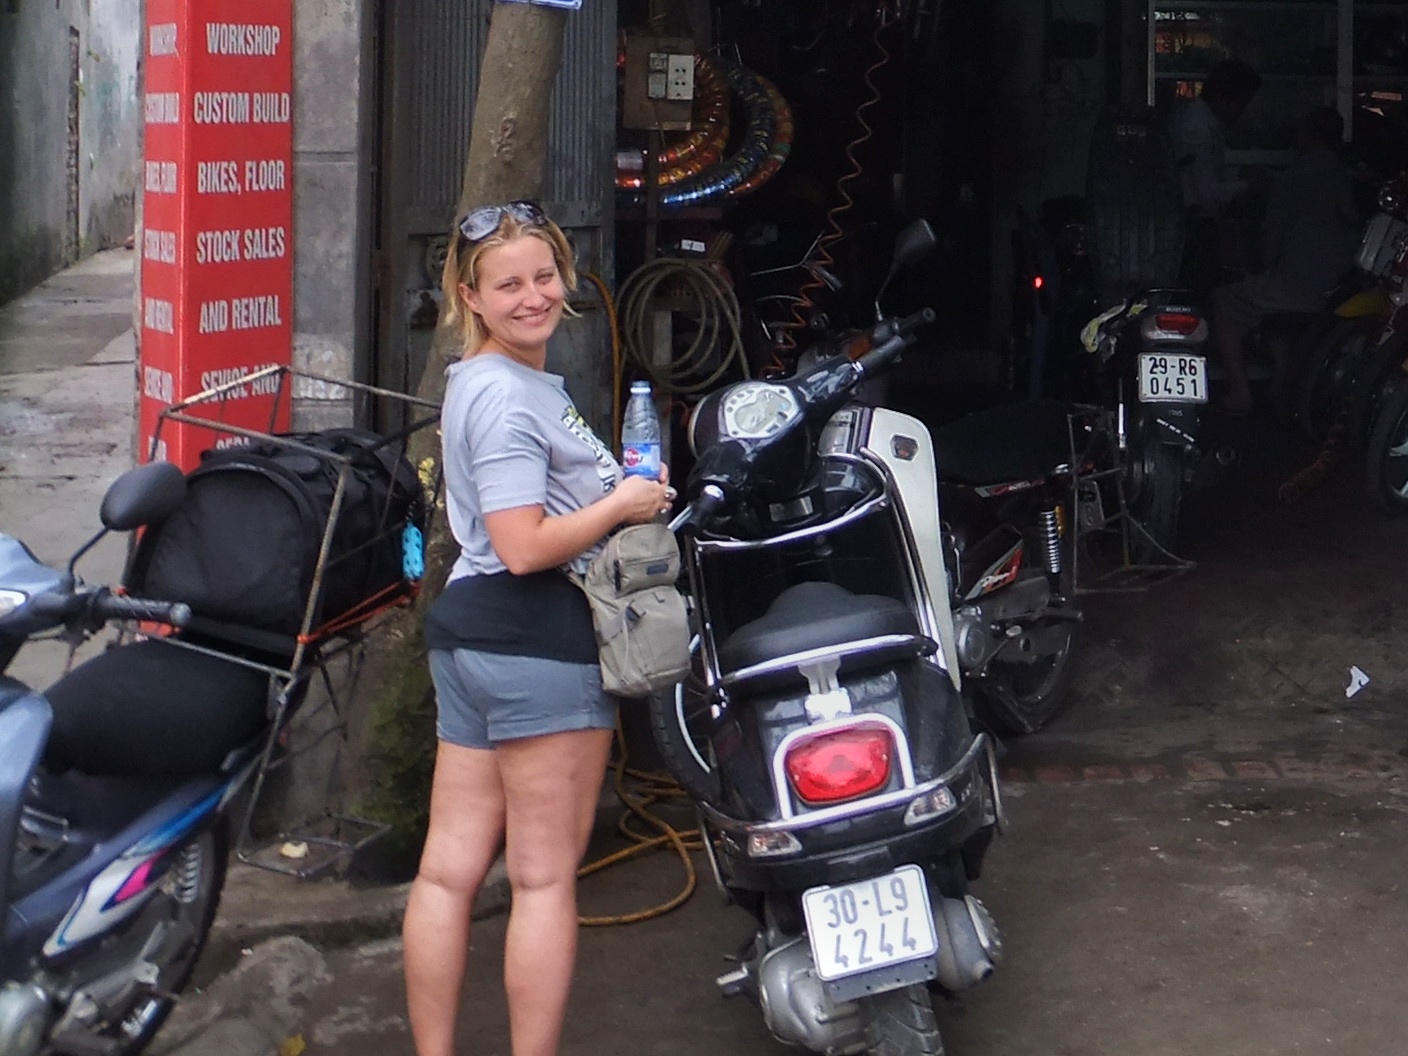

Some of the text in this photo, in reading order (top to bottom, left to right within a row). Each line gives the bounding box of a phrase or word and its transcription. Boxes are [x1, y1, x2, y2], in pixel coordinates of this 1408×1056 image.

[206, 22, 281, 56] WORKSHOP
[194, 92, 250, 124] CUSTOM
[253, 91, 290, 123] BUILD
[197, 161, 242, 195] BIKES,
[245, 160, 286, 192] FLOOR
[196, 231, 241, 264] STOCK
[244, 226, 286, 260] SALES
[199, 299, 229, 335] AND
[232, 294, 282, 332] RENTAL
[1148, 356, 1198, 377] 29-R6
[1149, 377, 1198, 397] 0451
[822, 875, 909, 930] 30-L9
[833, 916, 918, 969] 4244
